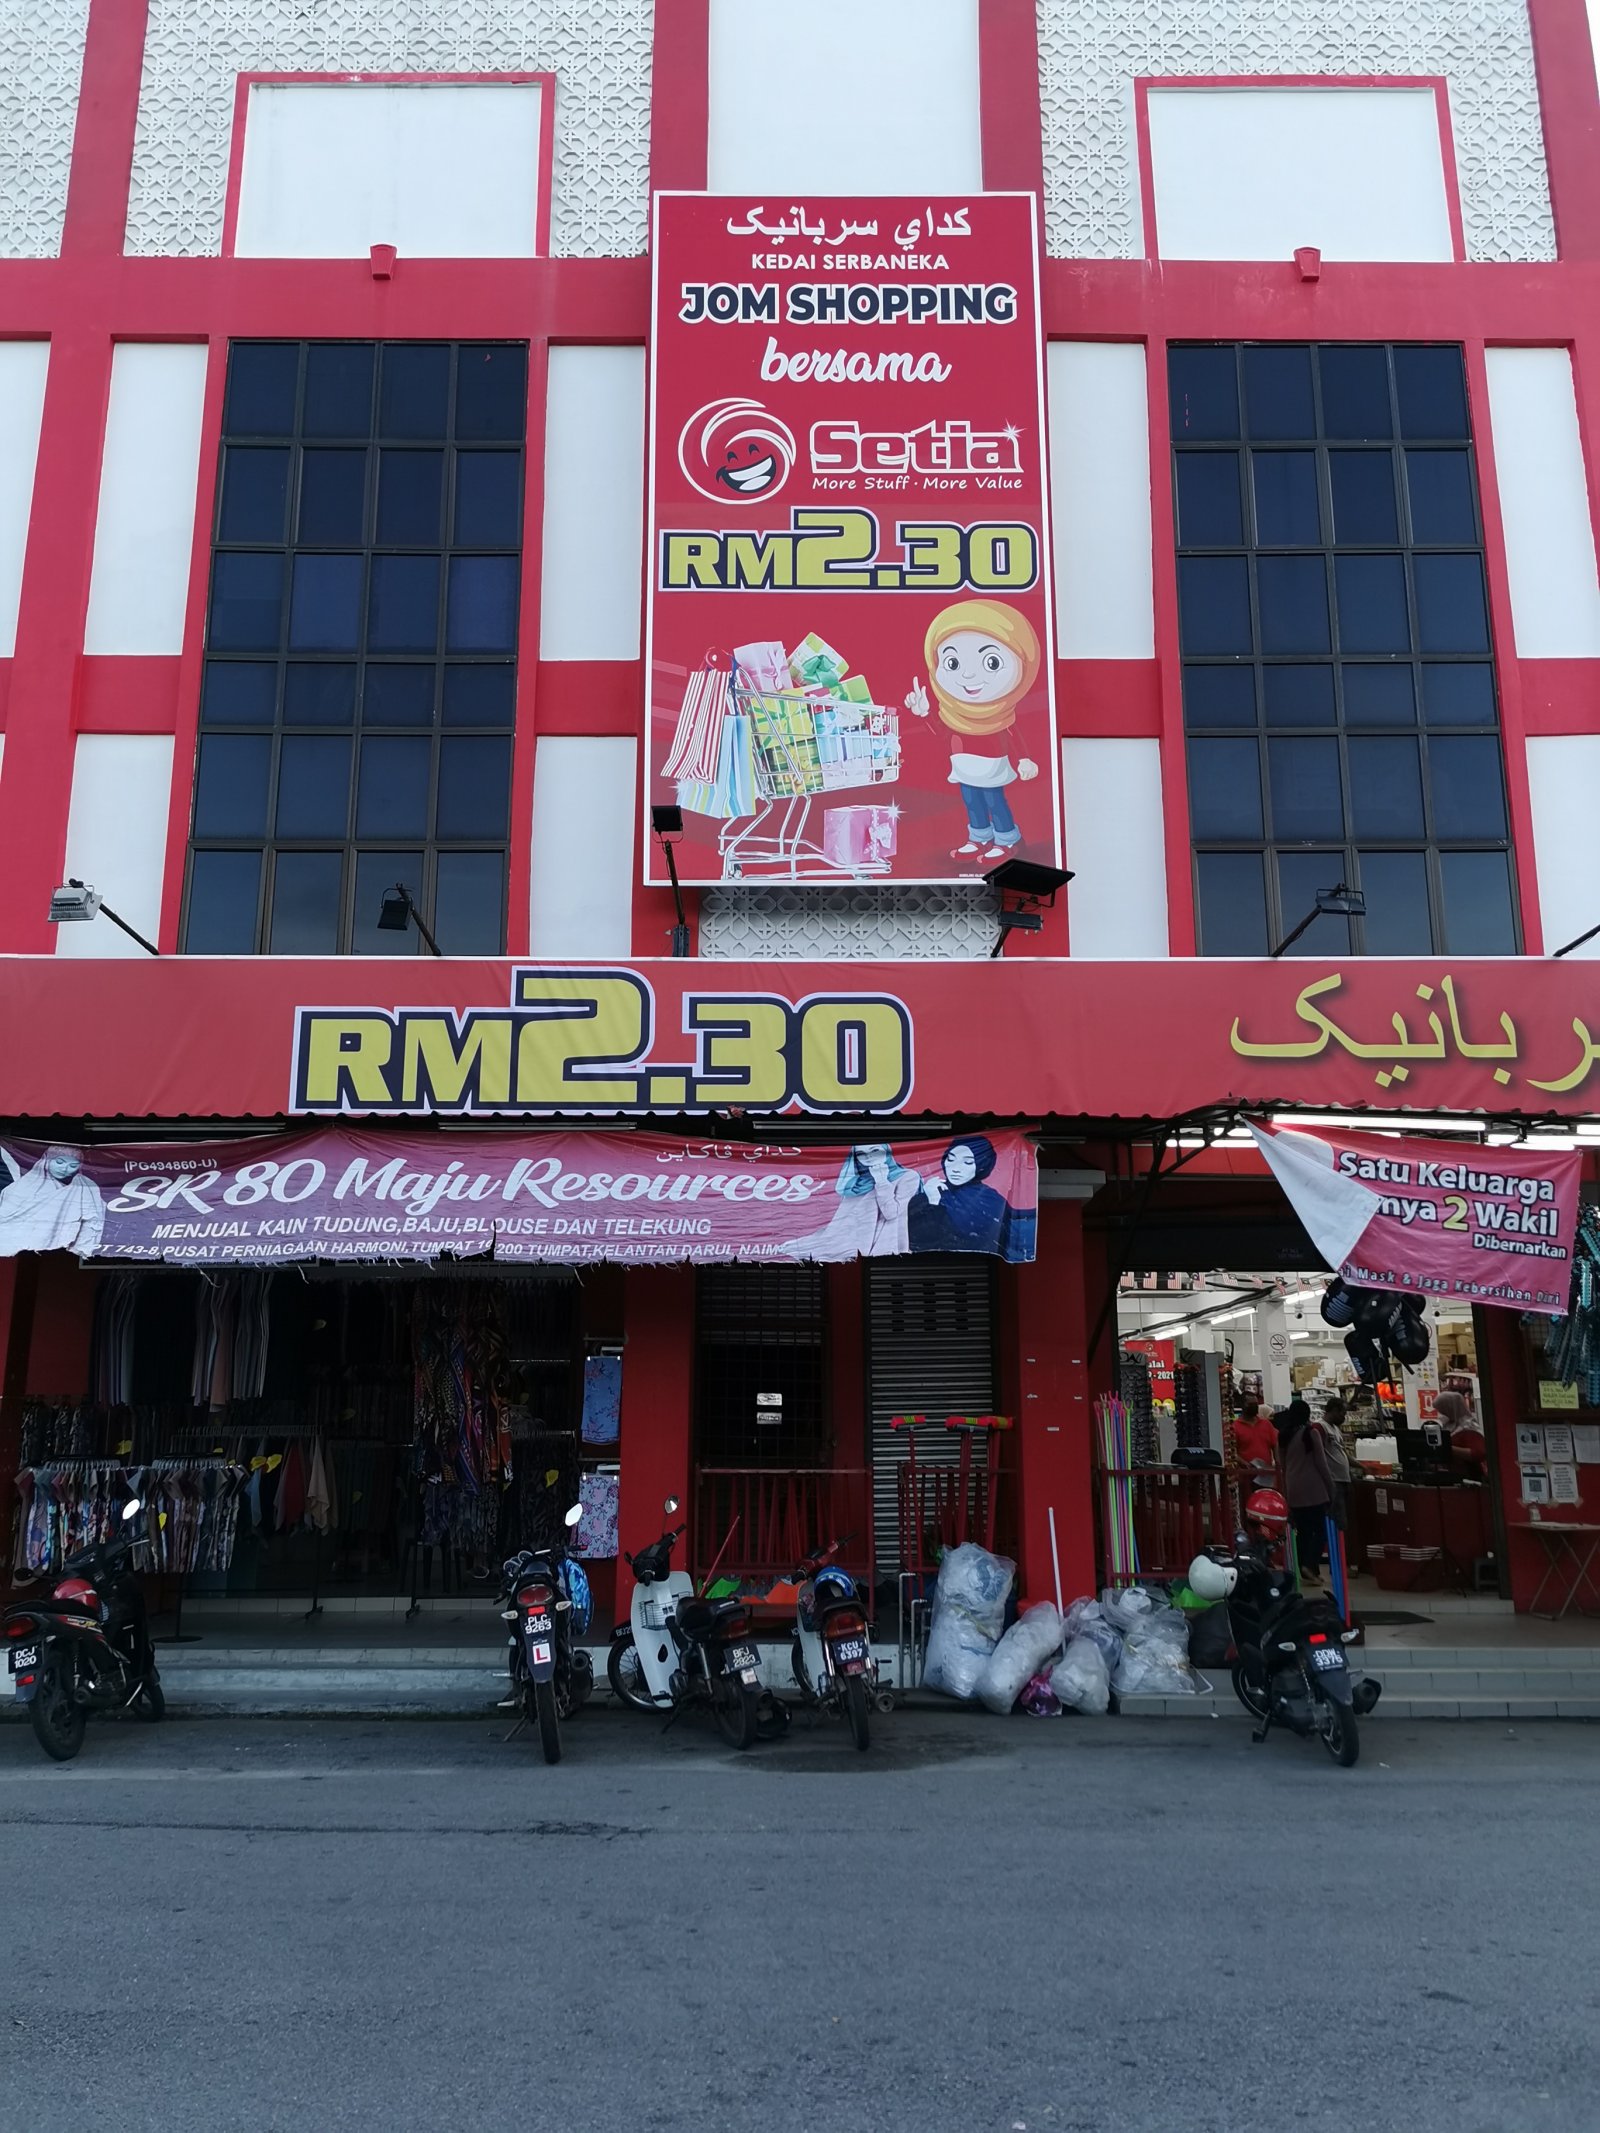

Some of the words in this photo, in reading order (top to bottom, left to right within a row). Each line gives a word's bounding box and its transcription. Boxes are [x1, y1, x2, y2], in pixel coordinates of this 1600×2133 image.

[752, 253, 816, 270] KEDAI
[822, 253, 949, 270] SERBANEKA
[679, 283, 779, 324] JOM
[786, 283, 1017, 324] SHOPPING
[761, 337, 952, 382] bersama
[809, 420, 1024, 474] Setia
[812, 477, 857, 490] More
[864, 475, 910, 490] Stuff
[923, 477, 967, 490] More
[976, 476, 1022, 490] Value
[659, 506, 1039, 593] RM2.30
[289, 966, 914, 1114] RM2.30
[223, 1158, 326, 1206] 80
[333, 1157, 502, 1216] Maju
[502, 1157, 826, 1208] Resources
[1338, 1152, 1411, 1184] Satu
[1417, 1161, 1554, 1204] Keluarga
[1378, 1196, 1438, 1225] nya
[1442, 1195, 1469, 1232] 2
[1474, 1201, 1559, 1237] Wakil
[152, 1222, 251, 1239] MENJUAL
[257, 1217, 308, 1236] KAIN
[553, 1219, 597, 1234] DAN
[603, 1219, 712, 1235] TELEKUNG
[162, 1245, 219, 1257] PUSAT
[221, 1240, 328, 1257] PERNIAGAAN
[681, 1244, 732, 1256] DARUL
[1473, 1233, 1567, 1259] Dibernarkan
[1358, 1268, 1395, 1282] Mask
[1402, 1273, 1412, 1285] &
[1417, 1275, 1449, 1292] Jaga
[1455, 1280, 1532, 1299] Kebersihan
[525, 1620, 552, 1635] 9263
[527, 1614, 548, 1626] PLC
[15, 1645, 36, 1659] DCJ
[732, 1646, 750, 1659] BFJ
[840, 1648, 863, 1660] 6397
[841, 1641, 859, 1652] KCU
[14, 1656, 37, 1668] 1020
